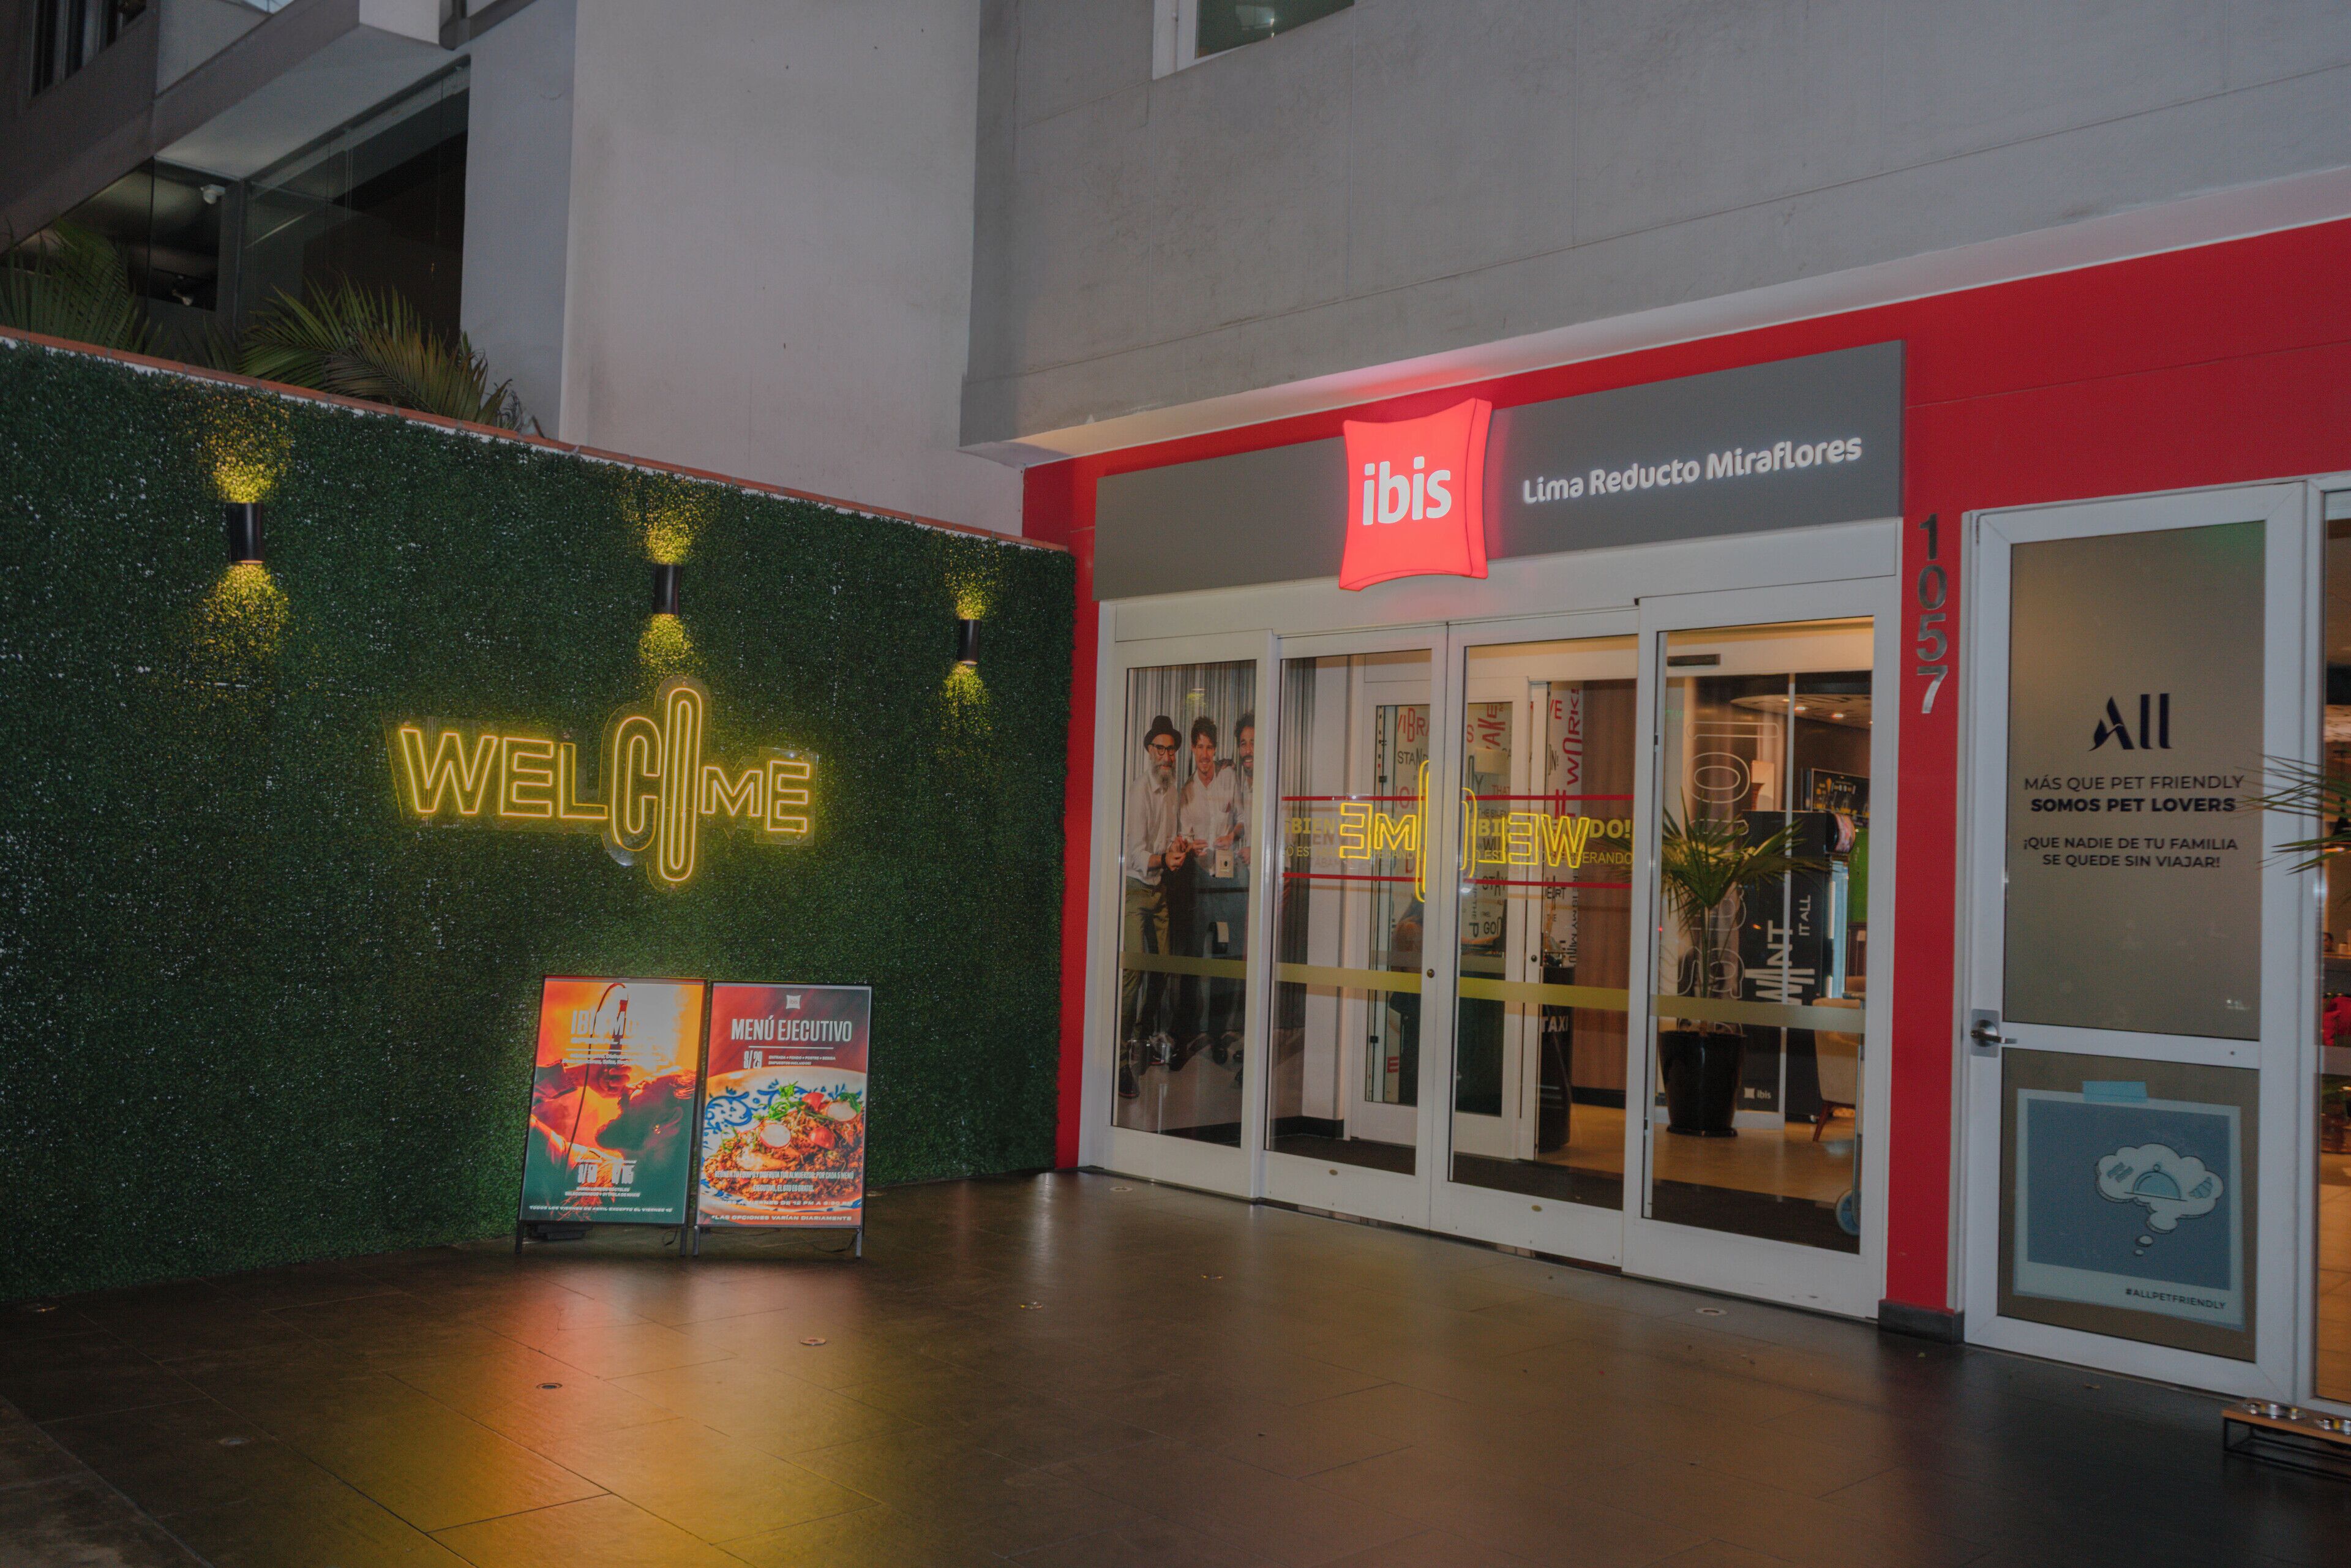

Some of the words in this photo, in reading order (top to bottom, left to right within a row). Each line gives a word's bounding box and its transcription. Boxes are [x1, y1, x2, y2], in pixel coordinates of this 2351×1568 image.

[1523, 475, 1584, 505] Lima
[1589, 459, 1701, 496] Reducto
[1706, 436, 1863, 479] Miraflores
[1362, 456, 1452, 527] ibis
[1916, 512, 1949, 714] 1057
[399, 686, 812, 883] WELCOME
[2024, 775, 2061, 790] MÁS
[2068, 776, 2105, 791] QUE
[2111, 776, 2144, 789] PET
[2150, 775, 2244, 789] FRIENDLY
[2030, 798, 2100, 812] SOMOS
[2107, 798, 2145, 812] PET
[2151, 797, 2237, 812] LOVERS
[2023, 837, 2060, 850] ¡QUE
[2064, 837, 2113, 850] NADIE
[2118, 838, 2140, 849] DE
[2144, 838, 2165, 850] TU
[2170, 838, 2238, 851] FAMILIA
[2042, 853, 2061, 866] SE
[2066, 853, 2120, 868] QUEDE
[2126, 854, 2151, 867] SIN
[2157, 855, 2221, 869] VIAJAR!
[731, 1015, 774, 1041] MENÚ
[777, 1019, 853, 1042] EJECUTIVO
[1539, 1015, 1569, 1033] TAXI
[2125, 1288, 2226, 1309] #ALLPETFRIENDLY
